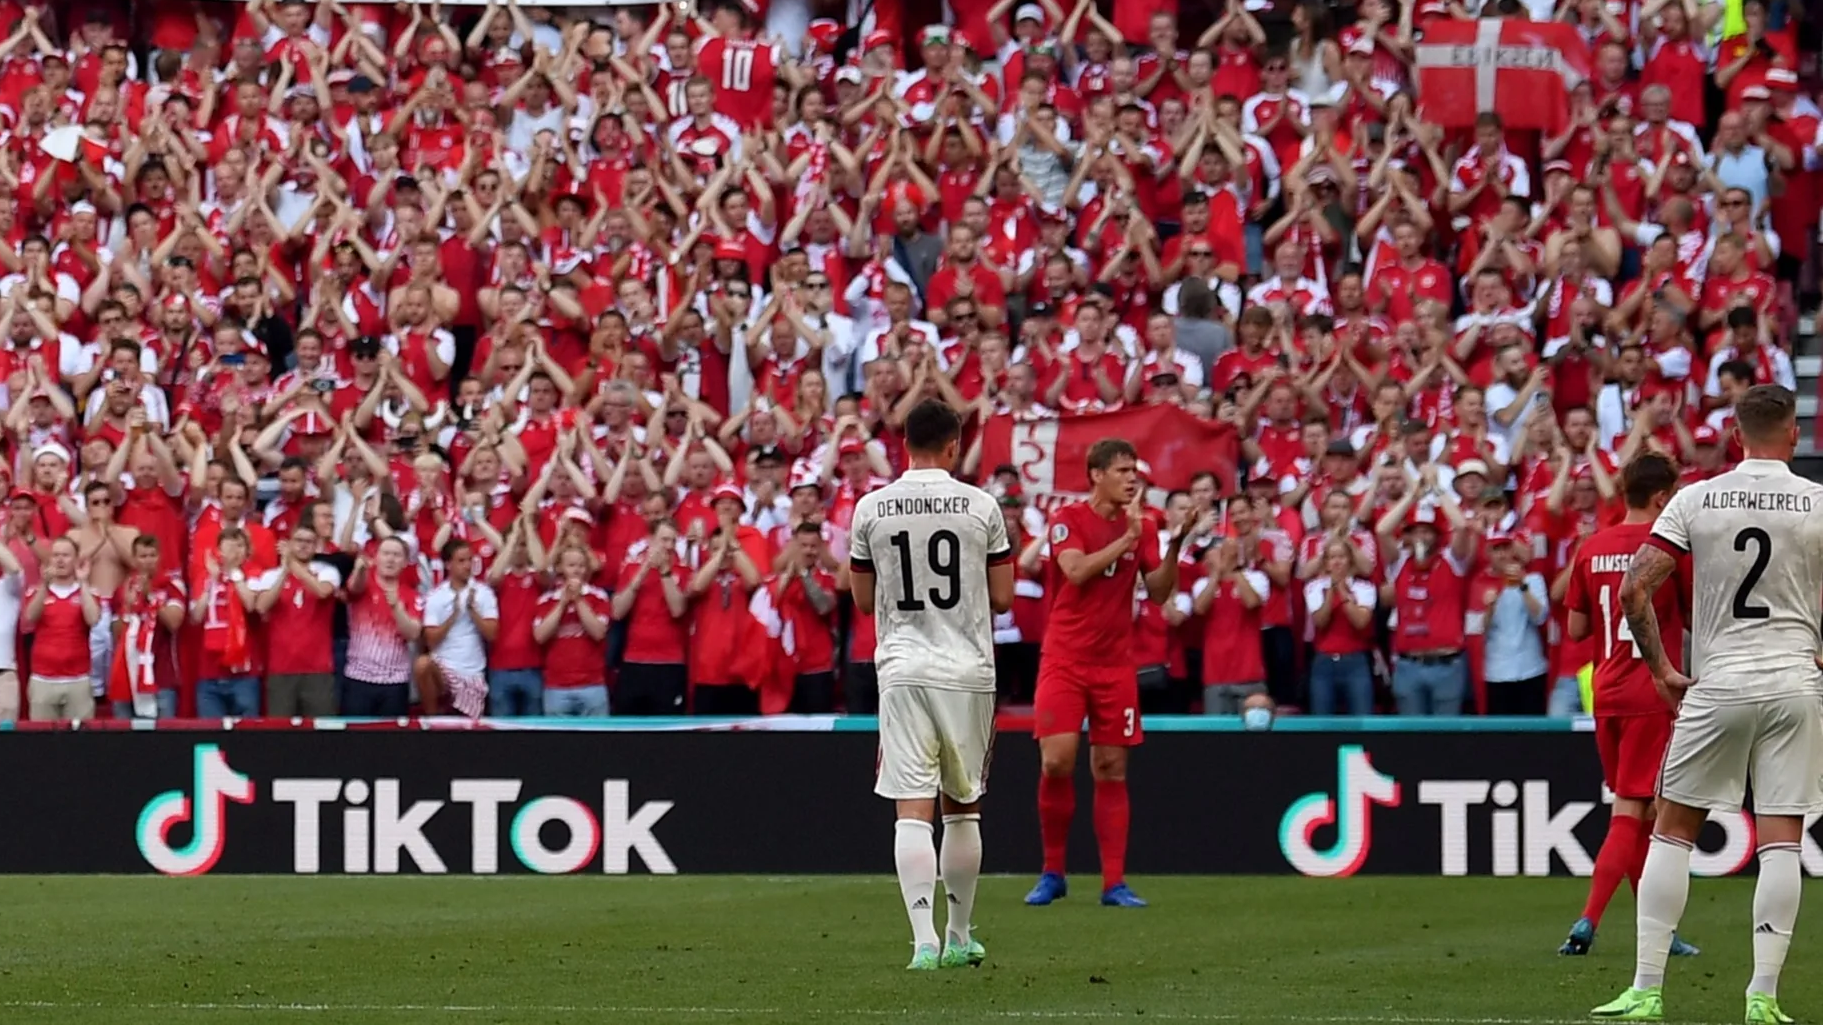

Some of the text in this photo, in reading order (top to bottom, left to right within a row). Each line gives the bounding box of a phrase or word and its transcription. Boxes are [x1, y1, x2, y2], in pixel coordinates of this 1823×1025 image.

[722, 47, 755, 92] 10
[877, 496, 970, 518] DENDONCKER
[1702, 491, 1812, 513] ALDERWEIRELD
[890, 529, 961, 612] 19
[1591, 554, 1636, 574] DAMSG
[1733, 527, 1772, 619] 2
[1123, 707, 1135, 737] 3
[272, 778, 677, 875] TikTok
[1418, 779, 1823, 877] Tiko
